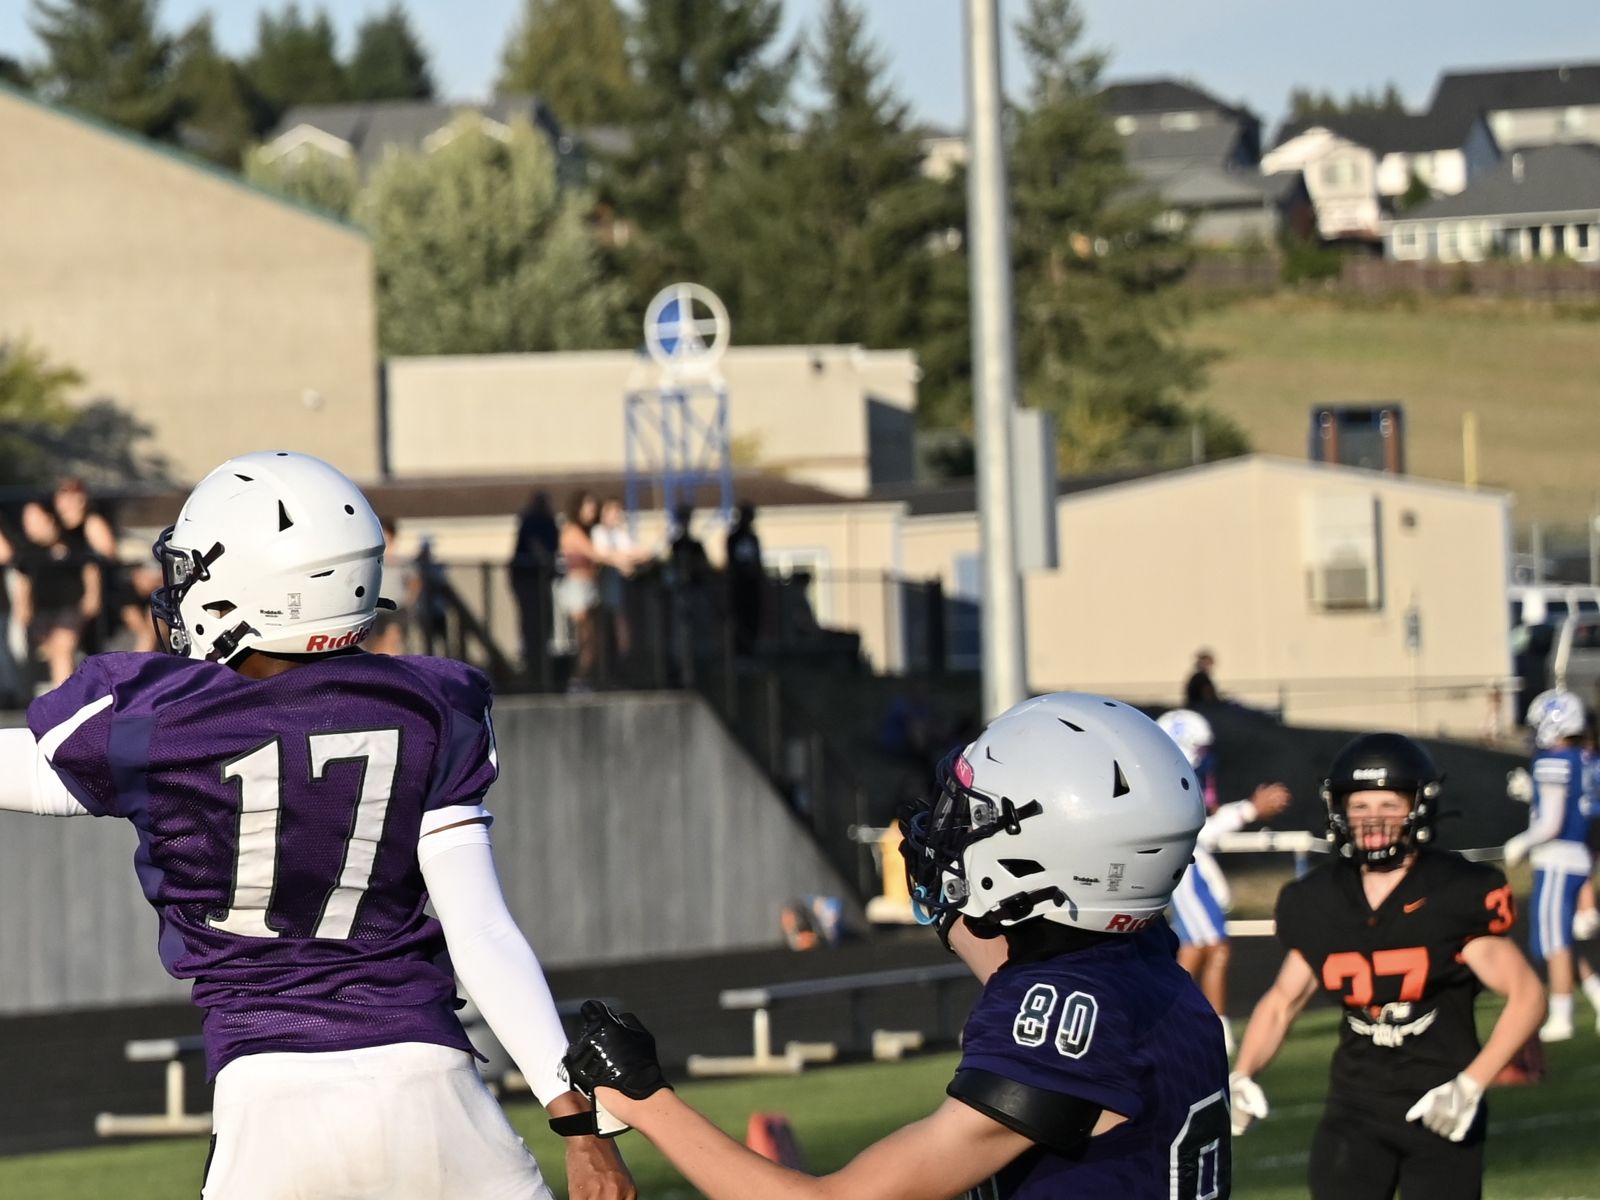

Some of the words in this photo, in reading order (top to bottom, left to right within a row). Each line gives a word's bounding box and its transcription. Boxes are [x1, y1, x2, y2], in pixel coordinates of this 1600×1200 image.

[306, 623, 372, 651] Ridde
[206, 727, 403, 940] 17
[1485, 885, 1517, 933] 3
[1322, 946, 1429, 1007] 37
[1013, 983, 1098, 1059] 80
